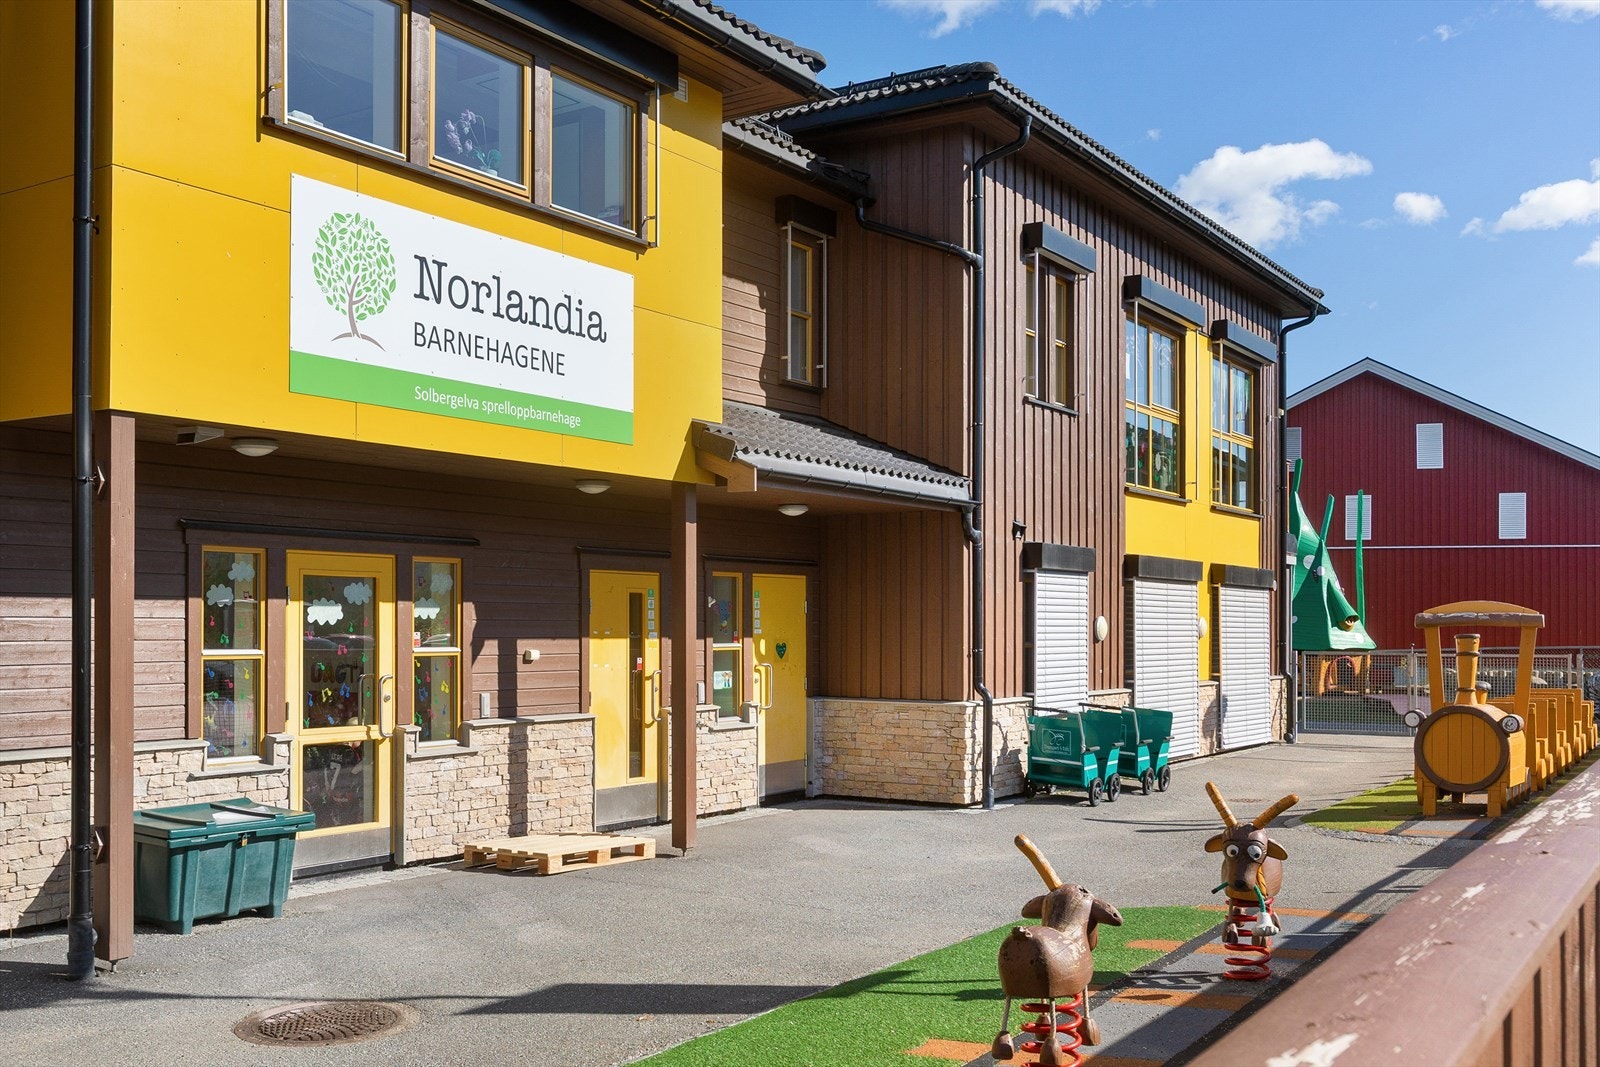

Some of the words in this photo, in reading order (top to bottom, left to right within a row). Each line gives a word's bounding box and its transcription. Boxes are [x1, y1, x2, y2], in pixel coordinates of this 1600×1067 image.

[414, 254, 607, 343] Norlandia
[414, 322, 565, 376] BARNEHAGENE
[414, 386, 479, 409] Solbergelva
[482, 400, 581, 428] sprelloppbarnehage
